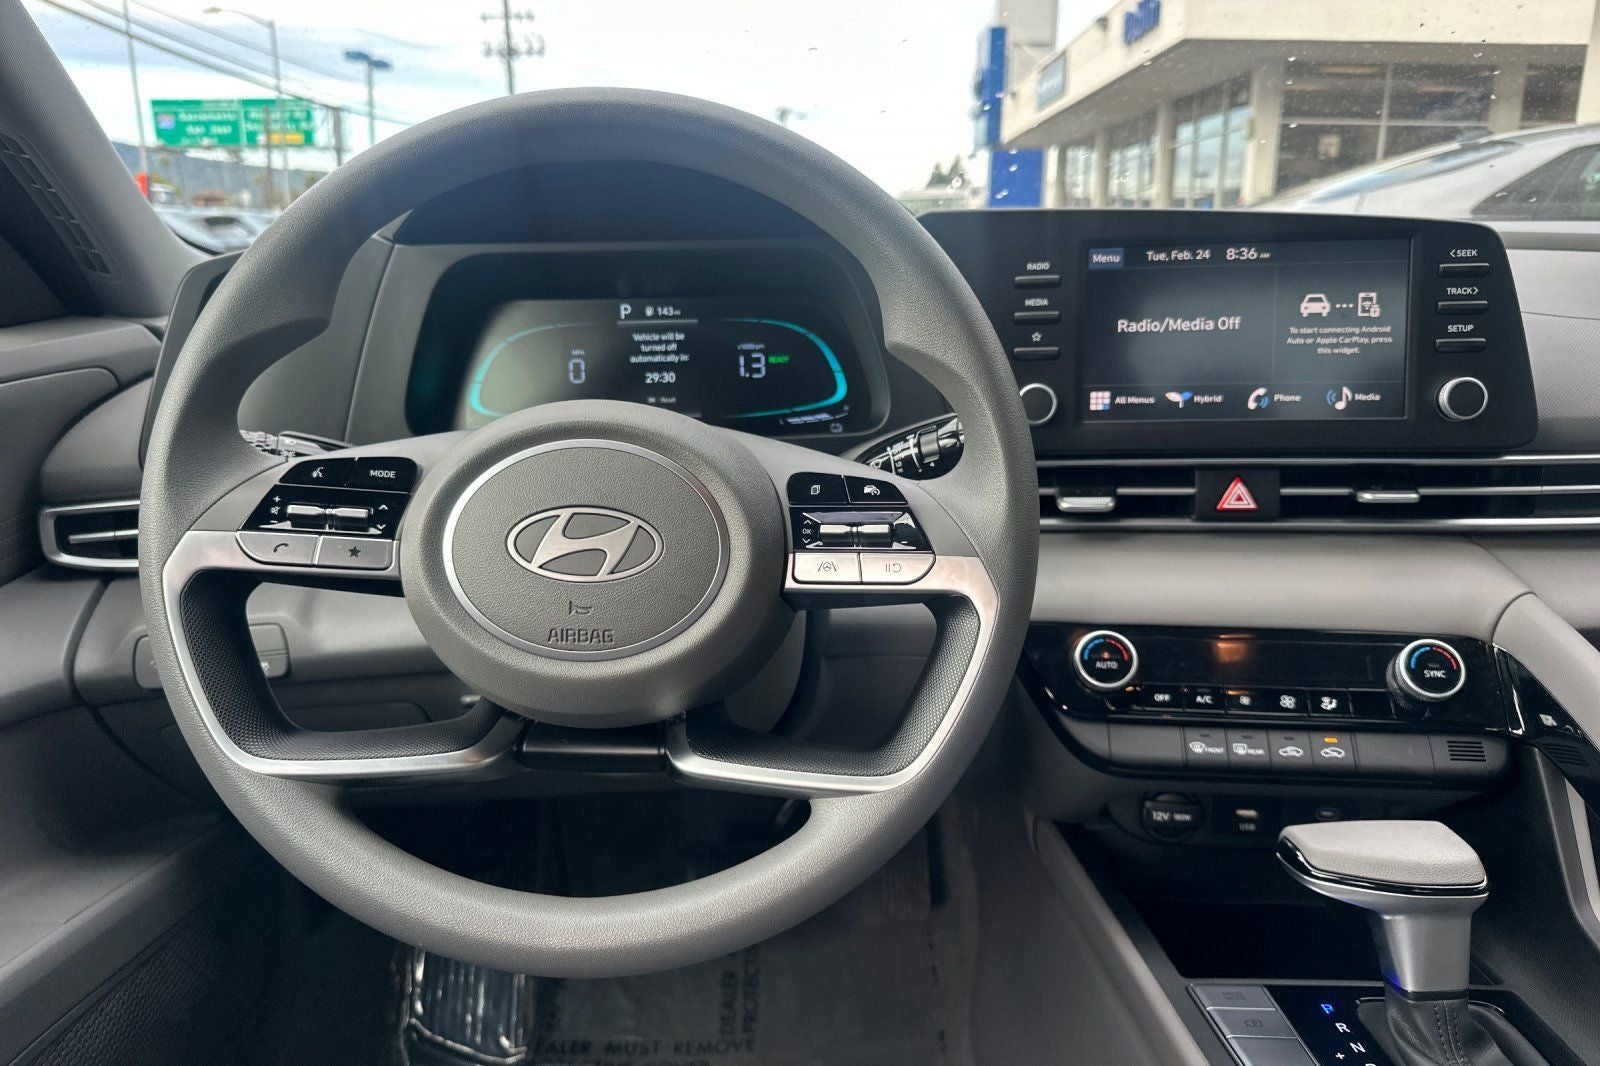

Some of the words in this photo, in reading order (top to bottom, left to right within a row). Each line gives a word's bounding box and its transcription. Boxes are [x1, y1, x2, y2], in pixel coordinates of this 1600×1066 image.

[1146, 251, 1169, 262] Tue,
[1171, 250, 1193, 260] Feb.
[1195, 250, 1211, 260] 24
[1226, 247, 1258, 260] 8:36
[1456, 249, 1478, 257] SEEK
[1092, 254, 1120, 264] Menu
[1026, 262, 1050, 271] RADIO
[1024, 299, 1049, 307] MEDIA
[619, 303, 632, 319] P
[1117, 316, 1215, 333] Radio/Media
[1217, 316, 1242, 330] Off
[1447, 324, 1474, 333] SETUP
[1319, 326, 1360, 334] connecting
[632, 332, 660, 341] Vehicle
[661, 332, 675, 340] will
[675, 332, 685, 340] be
[1315, 337, 1337, 345] Apple
[1371, 337, 1392, 345] press
[640, 344, 666, 352] turned
[667, 343, 678, 351] off
[1333, 347, 1360, 355] widget.
[629, 354, 679, 363] automatically
[768, 355, 790, 364] READY
[739, 353, 766, 378] 1.3
[568, 359, 586, 384] 0
[645, 371, 676, 383] 29:30
[1115, 396, 1126, 404] All
[1127, 396, 1155, 404] Menus
[1193, 394, 1222, 404] Hybrid
[1273, 393, 1301, 402] Phone
[1354, 393, 1381, 401] Media
[370, 469, 397, 479] MODE
[547, 628, 614, 644] AIRBAG
[1095, 660, 1119, 670] AUTO
[1423, 669, 1447, 679] SYNC
[1154, 693, 1171, 702] OFF
[1195, 695, 1213, 704] A/C
[1152, 810, 1170, 821] 12V
[1320, 1003, 1335, 1014] P
[1335, 1022, 1350, 1033] R
[1349, 1042, 1366, 1053] N
